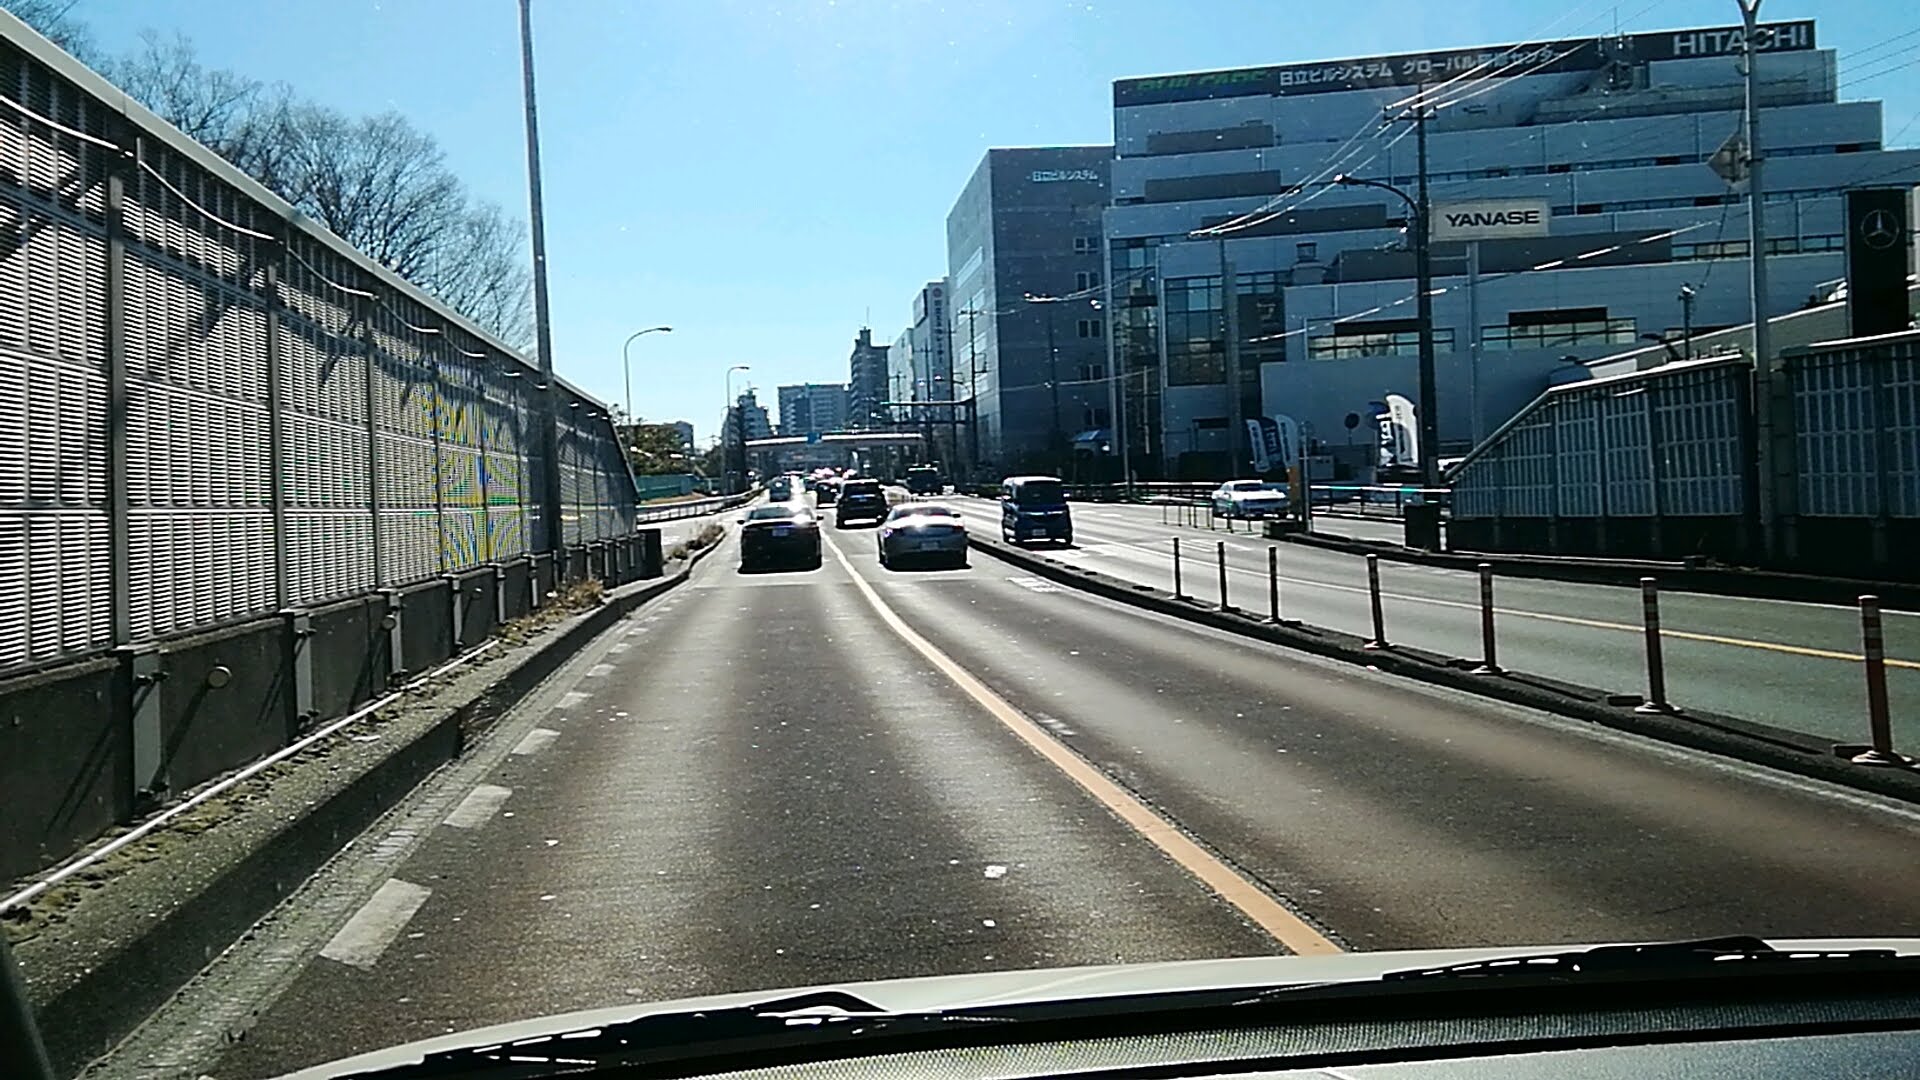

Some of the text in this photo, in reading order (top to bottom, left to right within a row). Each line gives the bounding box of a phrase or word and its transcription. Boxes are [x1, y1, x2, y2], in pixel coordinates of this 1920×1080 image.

[1673, 25, 1808, 56] HITACHI
[1279, 63, 1394, 87] 日立ビルシステム
[1445, 210, 1540, 228] YANASE
